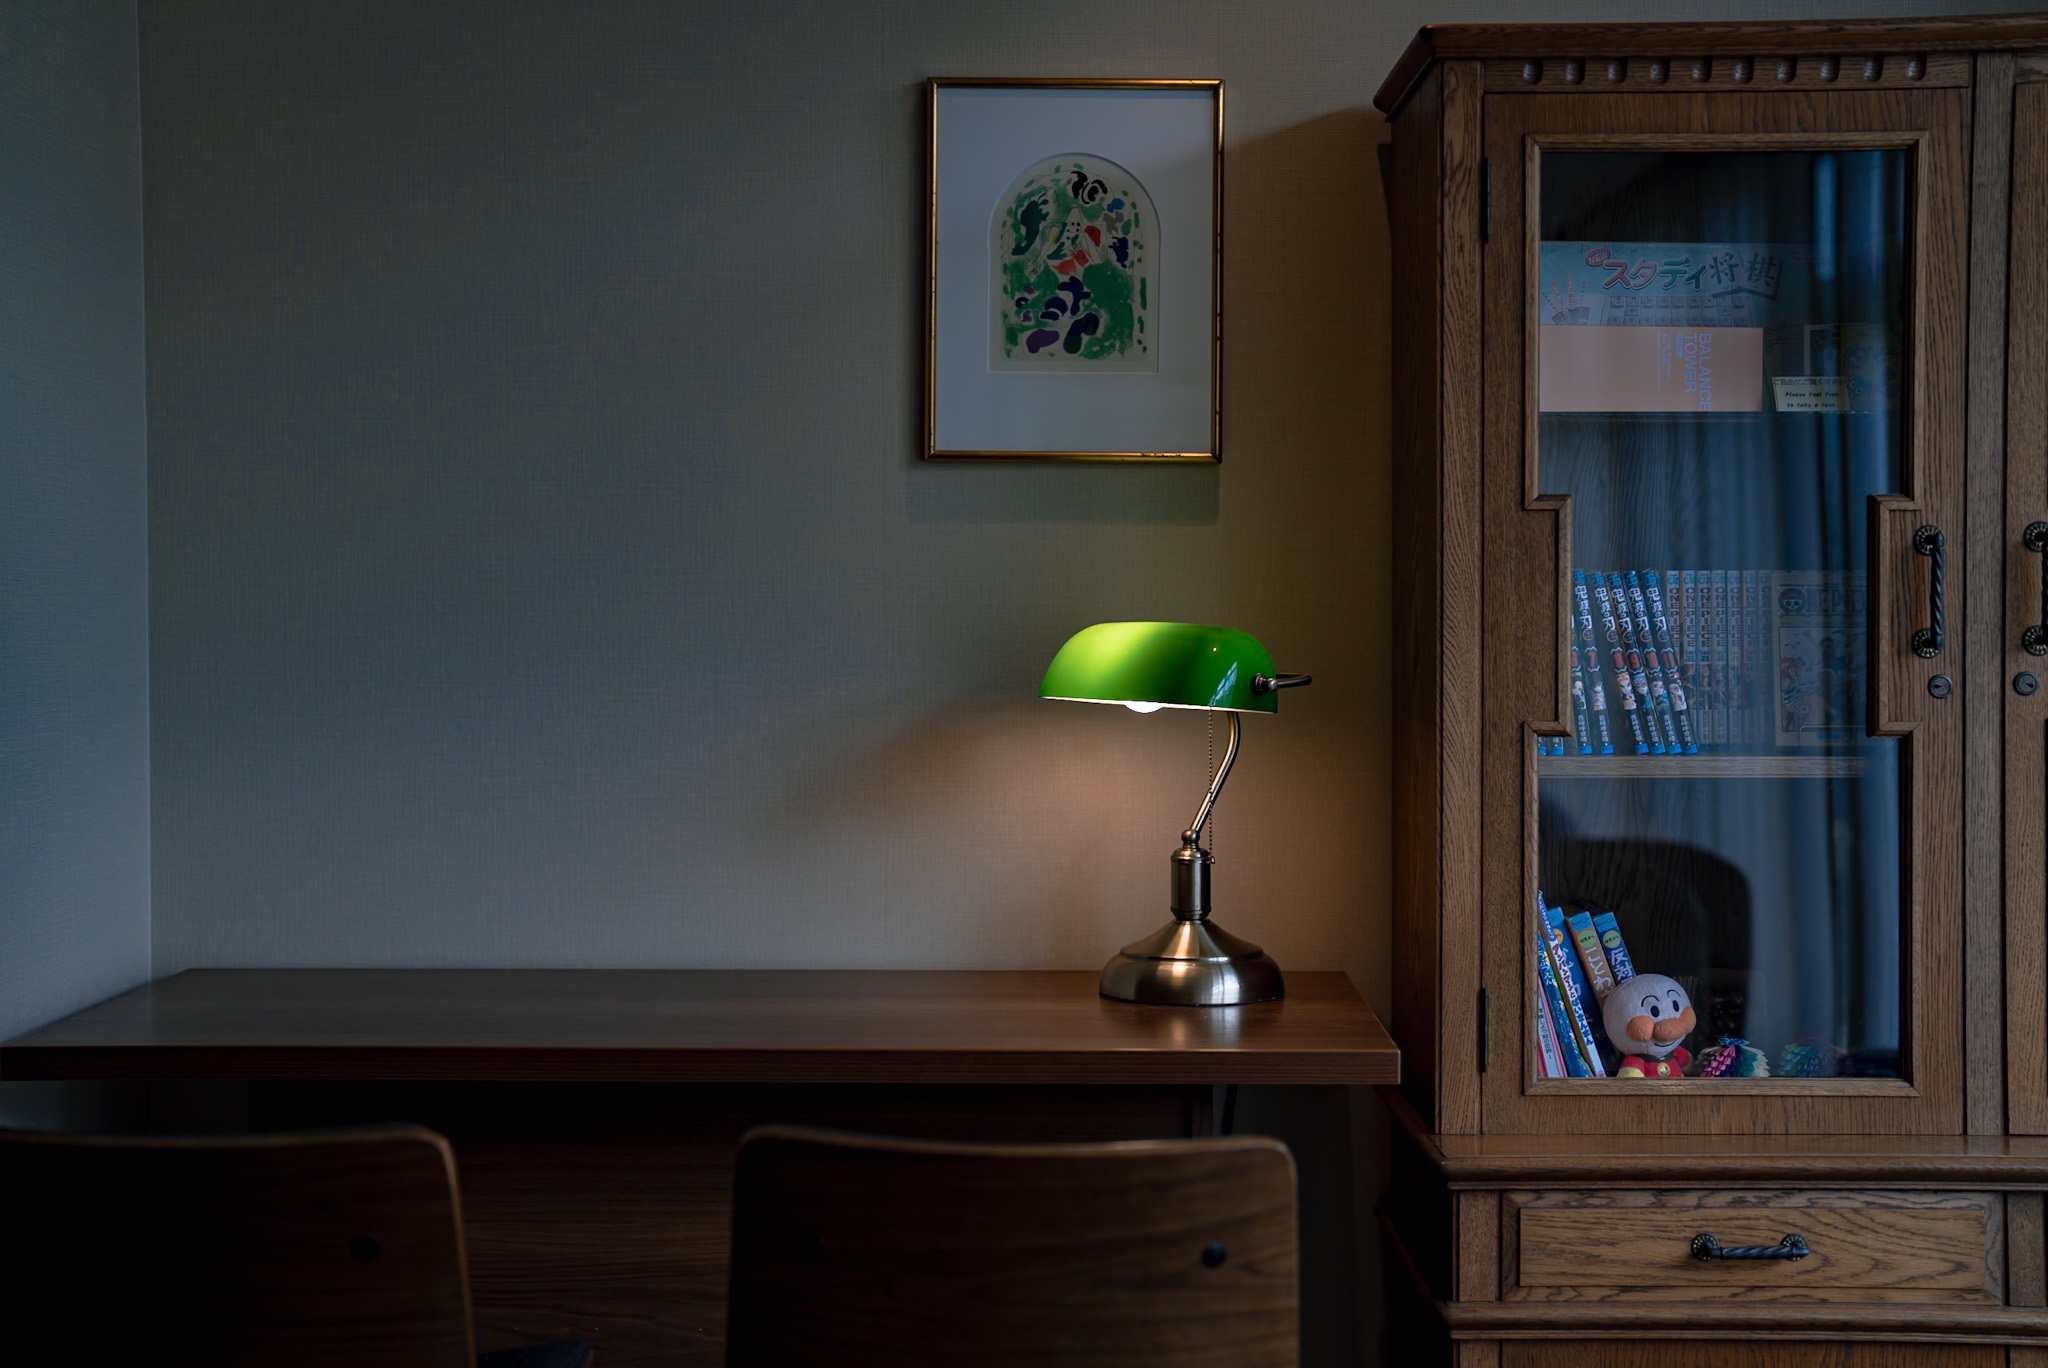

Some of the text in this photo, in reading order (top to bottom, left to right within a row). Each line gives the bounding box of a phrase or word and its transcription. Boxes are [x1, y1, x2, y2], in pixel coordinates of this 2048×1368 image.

[1588, 249, 1610, 265] NEW
[1602, 250, 1777, 292] スタディ将棋
[1684, 332, 1697, 393] TOWER
[1698, 332, 1712, 411] BALANCE
[1574, 586, 1592, 630] 鬼滅の刃
[1594, 588, 1615, 632] 鬼滅の刃
[1611, 588, 1631, 632] 鬼滅の刃
[1628, 588, 1649, 632] 鬼滅の刃
[1646, 588, 1667, 632] 鬼滅の刃
[1669, 587, 1680, 648] ONE PIECE
[1685, 587, 1696, 648] ONE PIECE
[1700, 587, 1711, 648] ONE PIECE
[1715, 587, 1726, 648] ONE PIECE
[1587, 651, 1596, 667] 7
[1611, 947, 1633, 982] 反対
